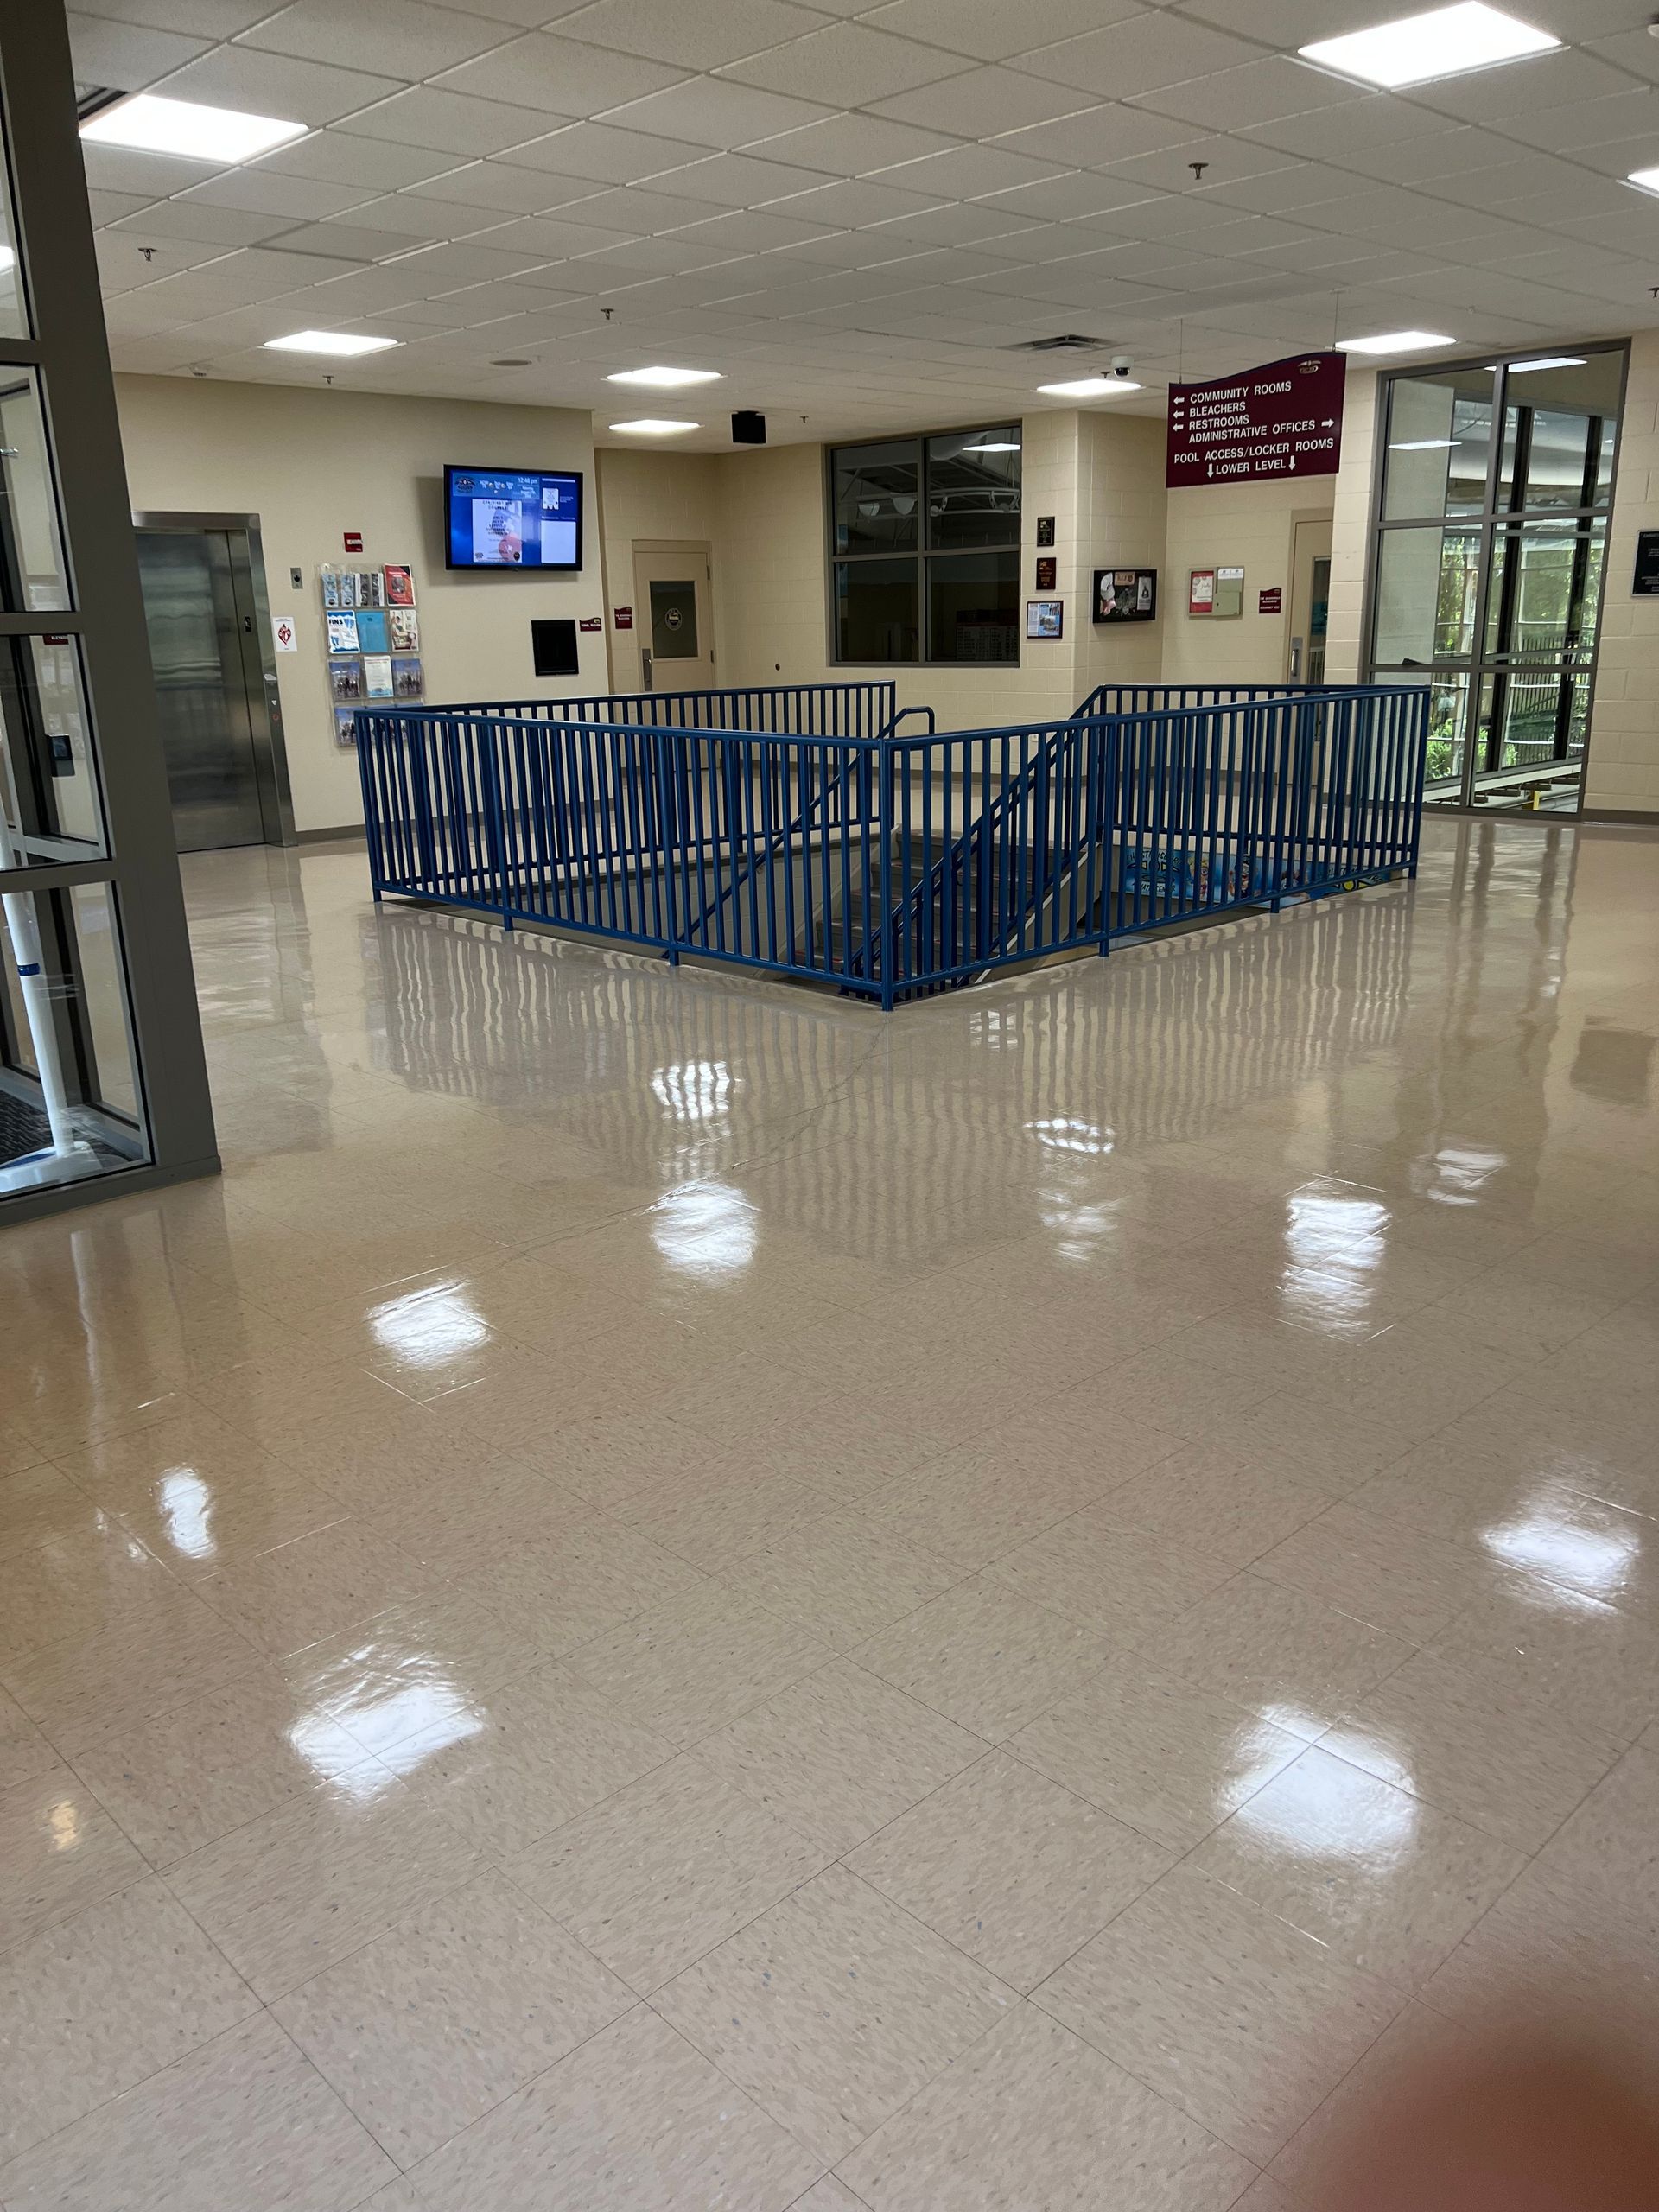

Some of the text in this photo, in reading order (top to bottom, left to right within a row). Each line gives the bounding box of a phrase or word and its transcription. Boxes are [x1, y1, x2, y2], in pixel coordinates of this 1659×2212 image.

[1190, 380, 1292, 404] COMMUNITY ROOMS
[1189, 401, 1246, 417] BLEACHERS
[1189, 414, 1249, 430] RESTROOMS
[1189, 419, 1315, 443] ADMINISTRATIVE OFFICES
[1174, 437, 1334, 463] POOL ACCESS/LOCKER ROOMS
[1216, 459, 1286, 474] LOWER LEVEL
